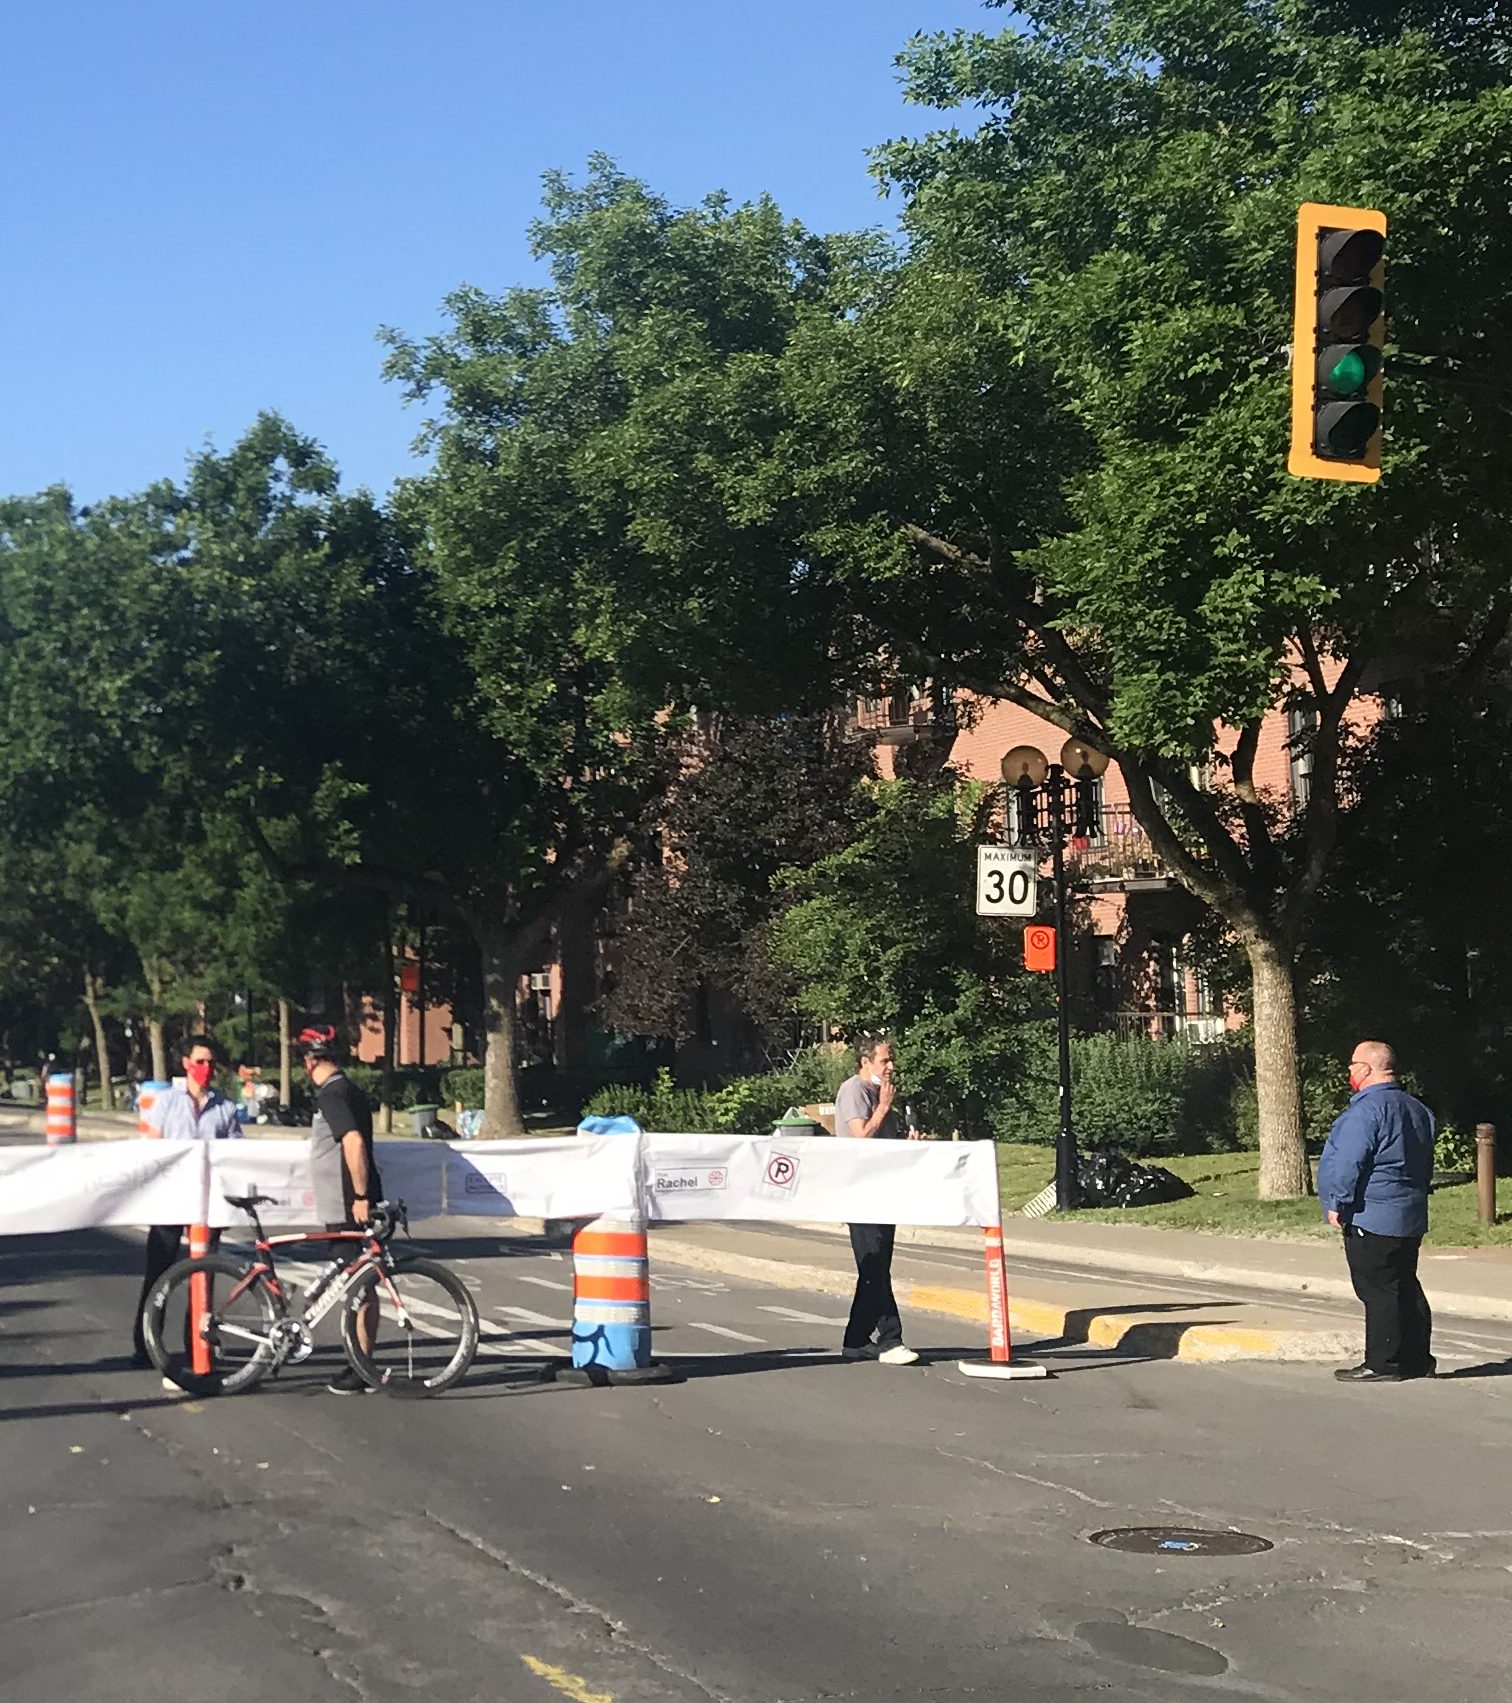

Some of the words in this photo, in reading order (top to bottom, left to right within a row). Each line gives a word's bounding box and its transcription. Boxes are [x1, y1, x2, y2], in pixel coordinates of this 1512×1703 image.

[984, 852, 1032, 862] MAXIMUM
[985, 869, 1029, 905] 30
[656, 1177, 698, 1189] Rachel
